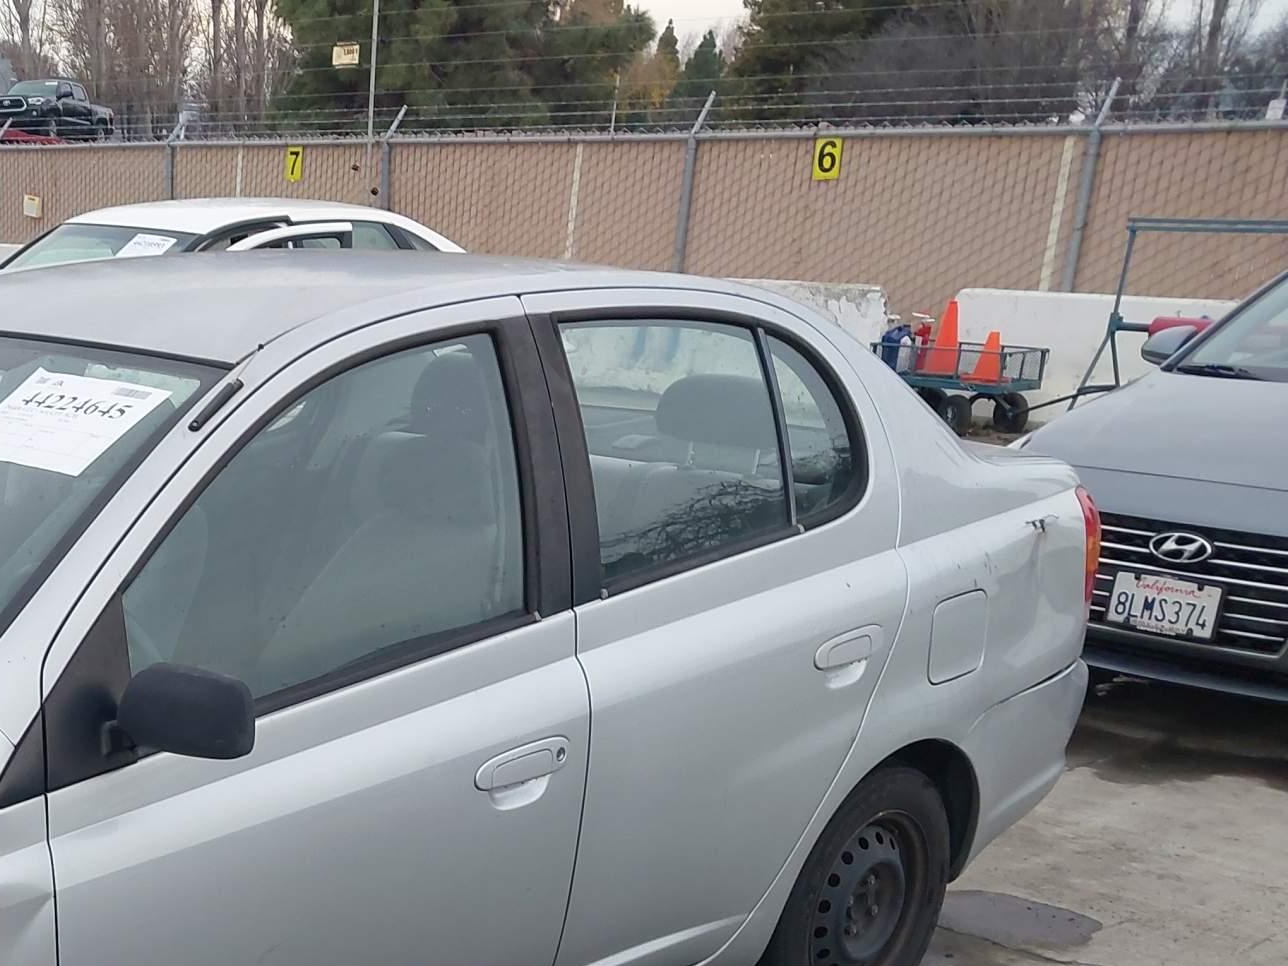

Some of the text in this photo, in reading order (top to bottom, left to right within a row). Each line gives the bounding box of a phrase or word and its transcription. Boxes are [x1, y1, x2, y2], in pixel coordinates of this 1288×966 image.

[288, 150, 301, 176] 7
[818, 141, 837, 174] 6
[21, 391, 134, 420] 44224645
[1135, 577, 1201, 599] California
[1114, 591, 1207, 631] 8LMS374
